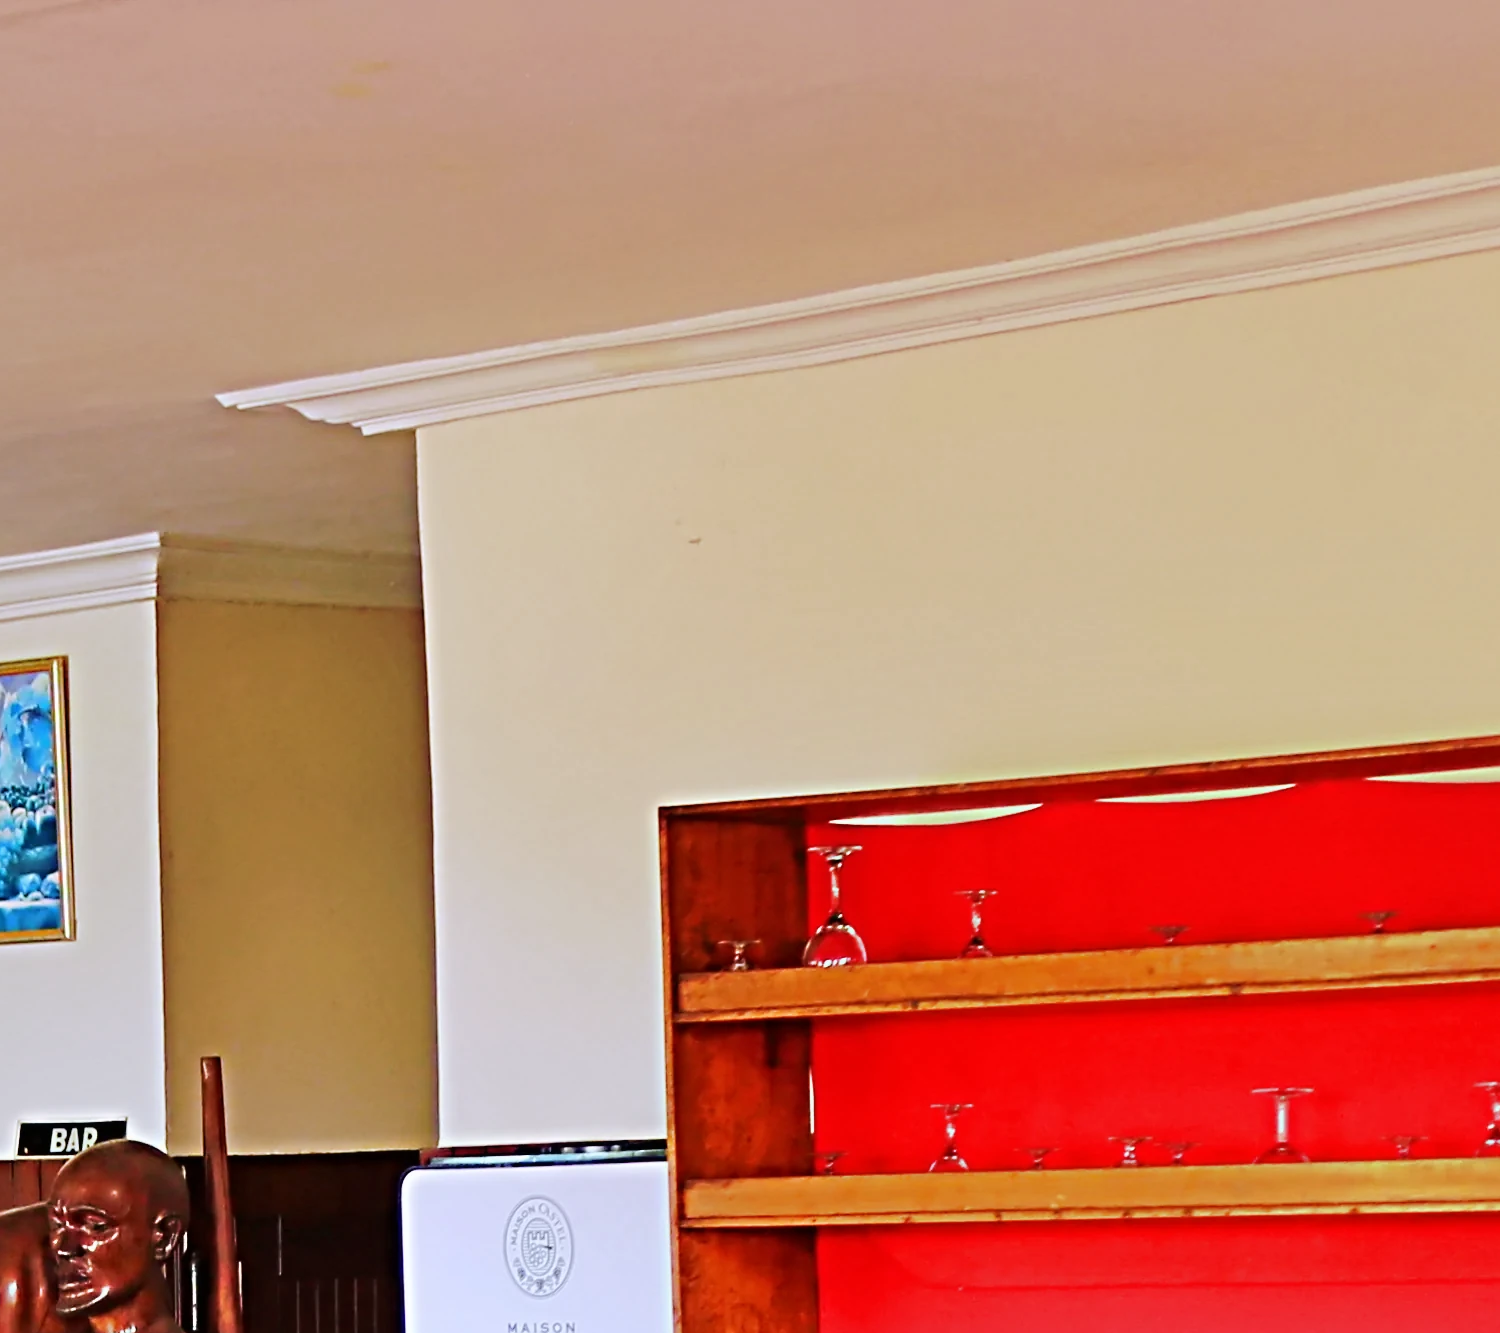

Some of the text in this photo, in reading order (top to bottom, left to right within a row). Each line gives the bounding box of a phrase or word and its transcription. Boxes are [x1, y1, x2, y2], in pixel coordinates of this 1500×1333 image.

[50, 1127, 98, 1152] BAR
[511, 1206, 536, 1245] MAISON
[507, 1322, 576, 1333] MAISON
